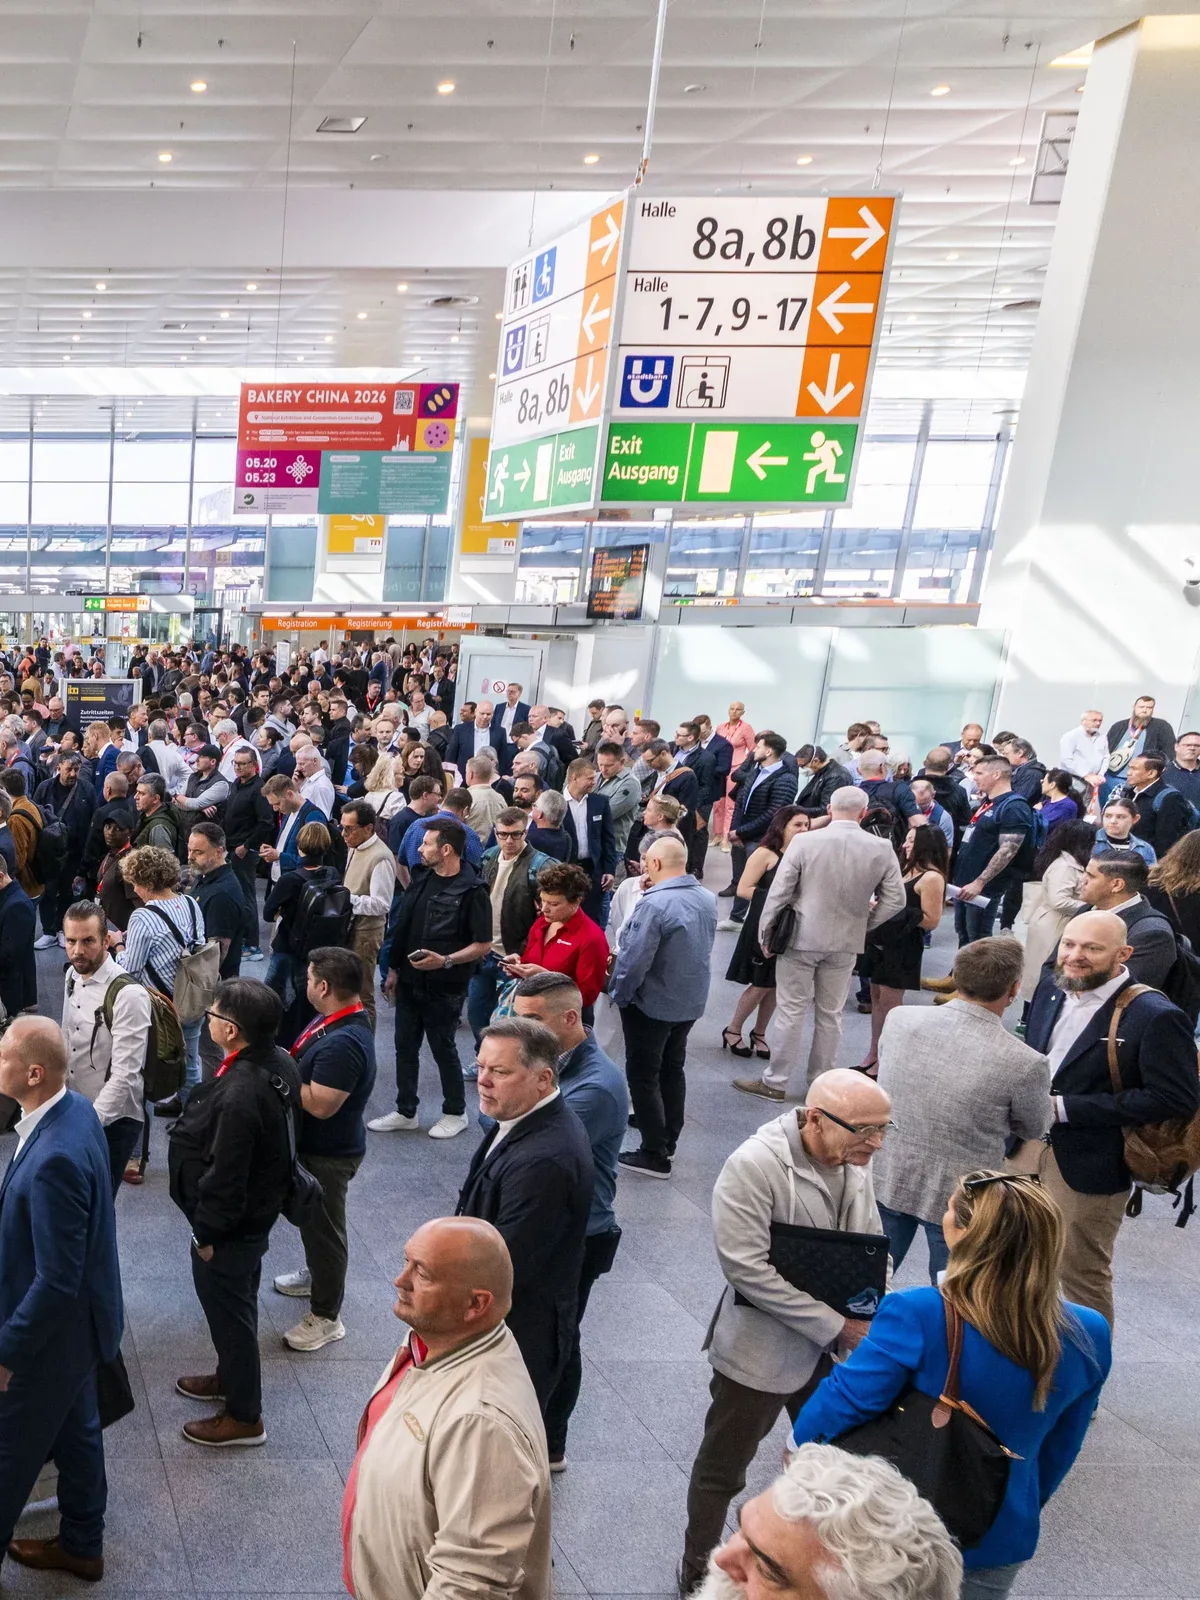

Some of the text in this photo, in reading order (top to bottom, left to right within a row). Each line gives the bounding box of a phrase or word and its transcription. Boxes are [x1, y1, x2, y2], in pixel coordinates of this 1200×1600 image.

[641, 202, 677, 218] Halle
[634, 277, 669, 293] Halle
[247, 389, 387, 404] BAKERY CHINA 2026
[499, 390, 514, 405] Halle
[559, 442, 576, 462] Exit
[609, 435, 642, 456] Exit
[245, 458, 278, 468] 05.20
[244, 472, 276, 483] 05.23
[557, 466, 593, 487] Ausgang
[608, 460, 680, 485] Ausgang
[277, 619, 318, 630] Registration
[347, 619, 392, 630] Registrierung
